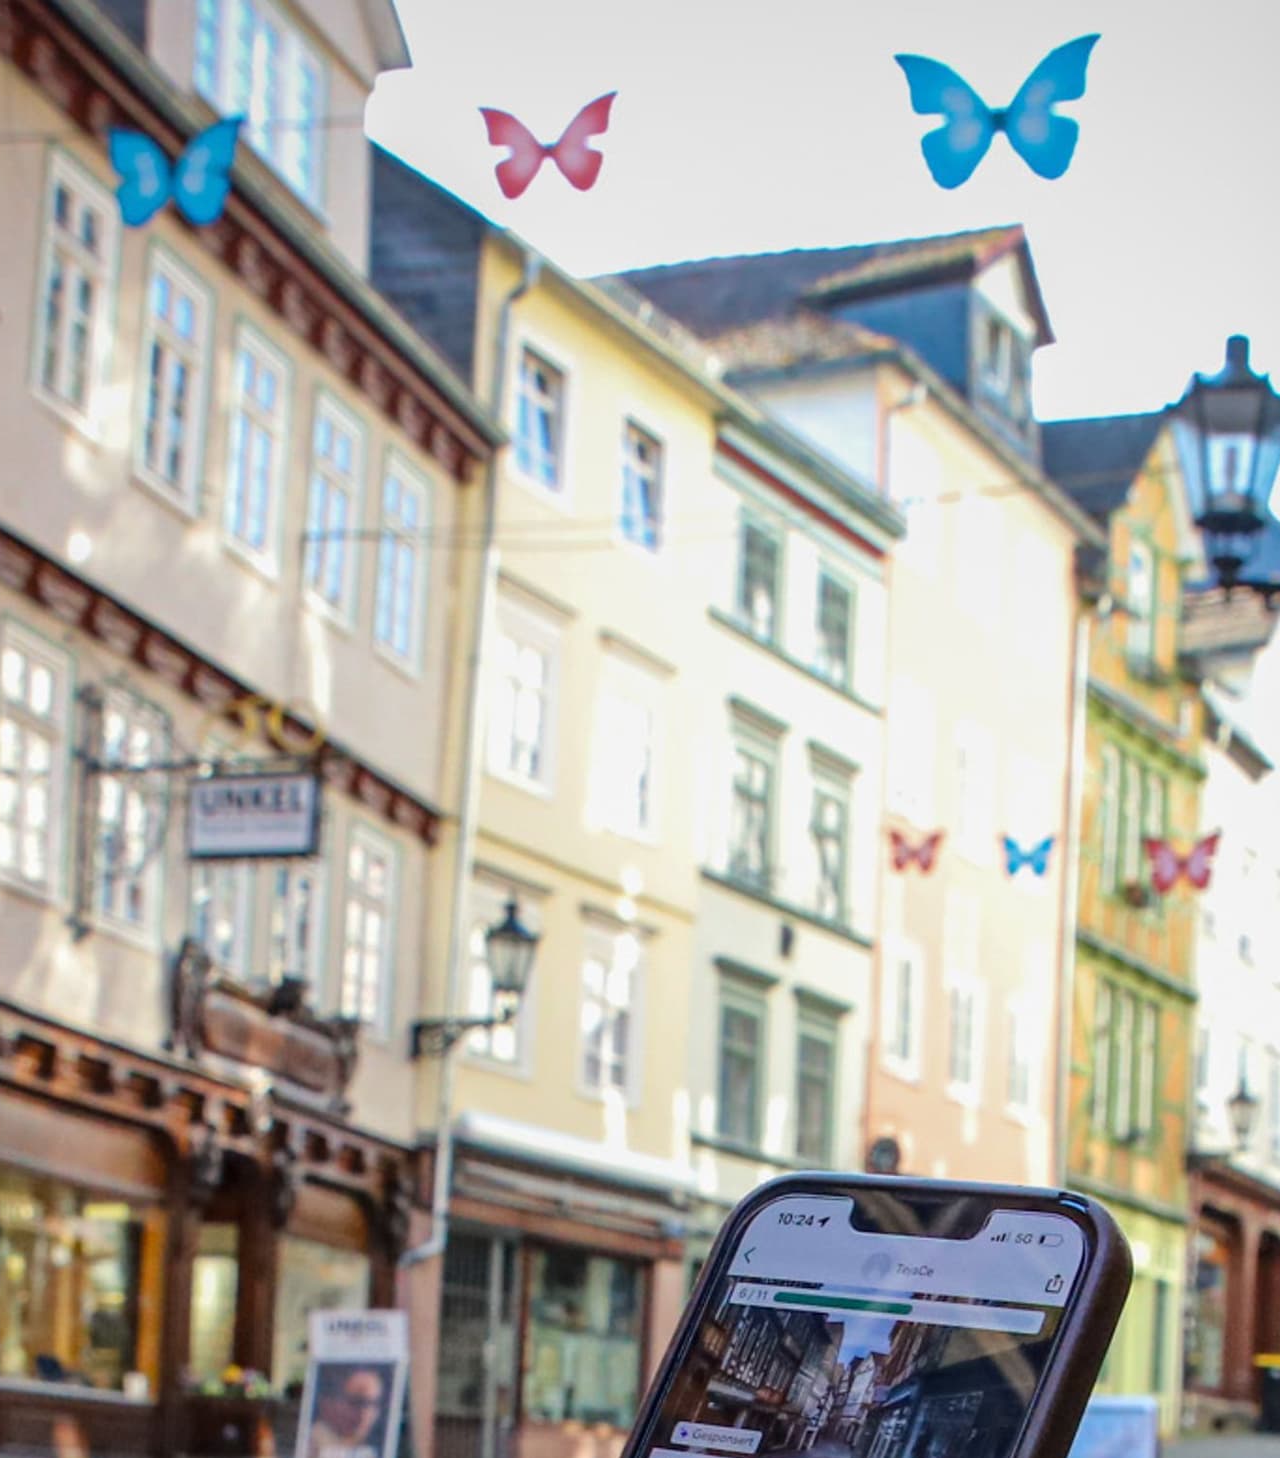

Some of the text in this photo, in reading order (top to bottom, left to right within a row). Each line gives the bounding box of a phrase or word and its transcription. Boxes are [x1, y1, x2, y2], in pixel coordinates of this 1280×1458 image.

[198, 783, 302, 815] UNKEL
[778, 1212, 815, 1227] 10:24
[1014, 1232, 1033, 1245] 5G
[692, 1428, 756, 1447] Gesponsert
